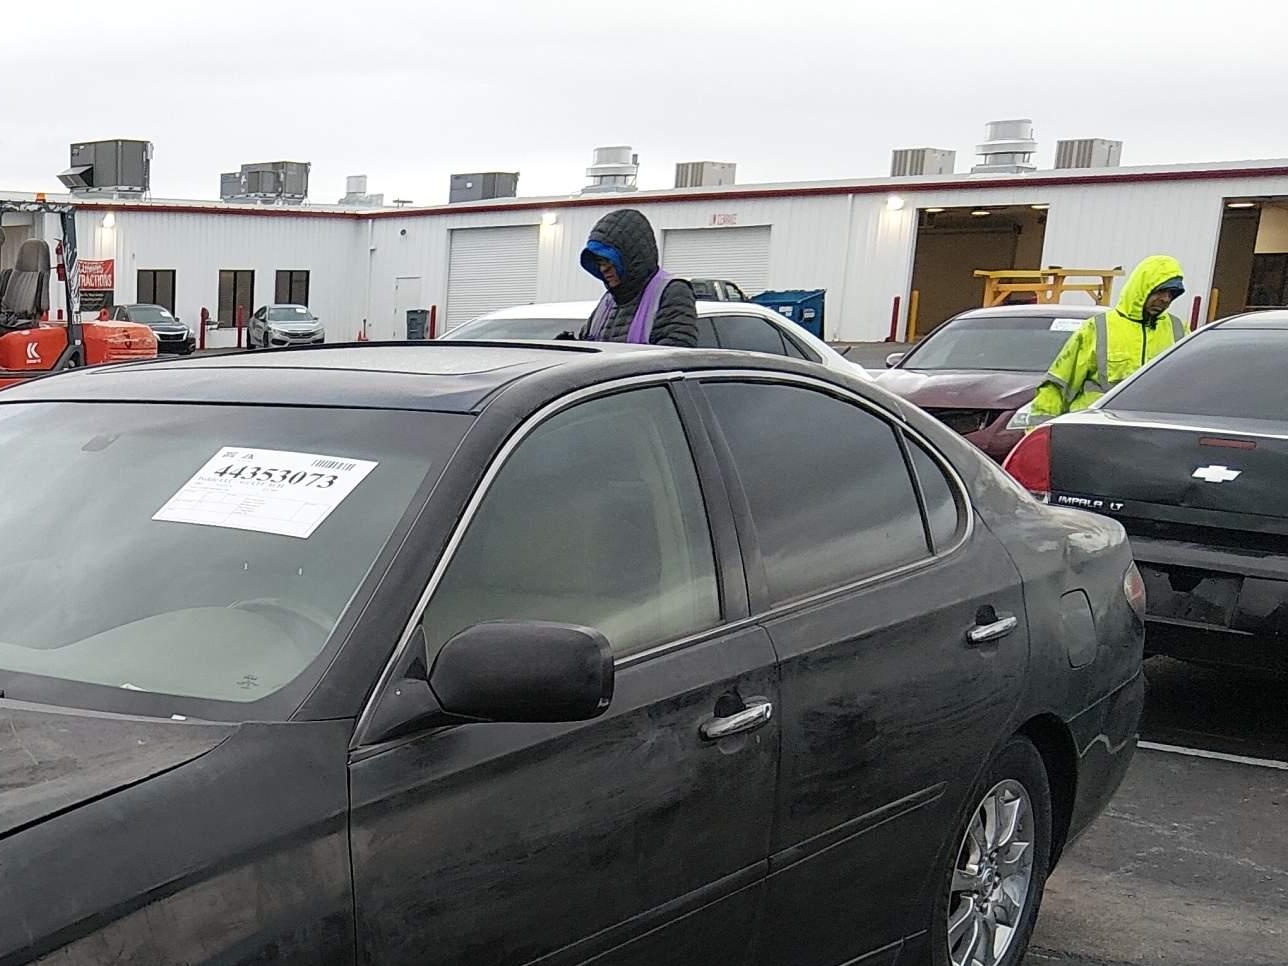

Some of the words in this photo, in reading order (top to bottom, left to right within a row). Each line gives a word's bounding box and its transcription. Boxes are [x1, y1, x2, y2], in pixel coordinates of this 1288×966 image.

[79, 274, 112, 288] TRACTIONS
[214, 464, 339, 489] 44353073
[1058, 495, 1103, 508] IMPALA
[1109, 502, 1124, 511] LT
